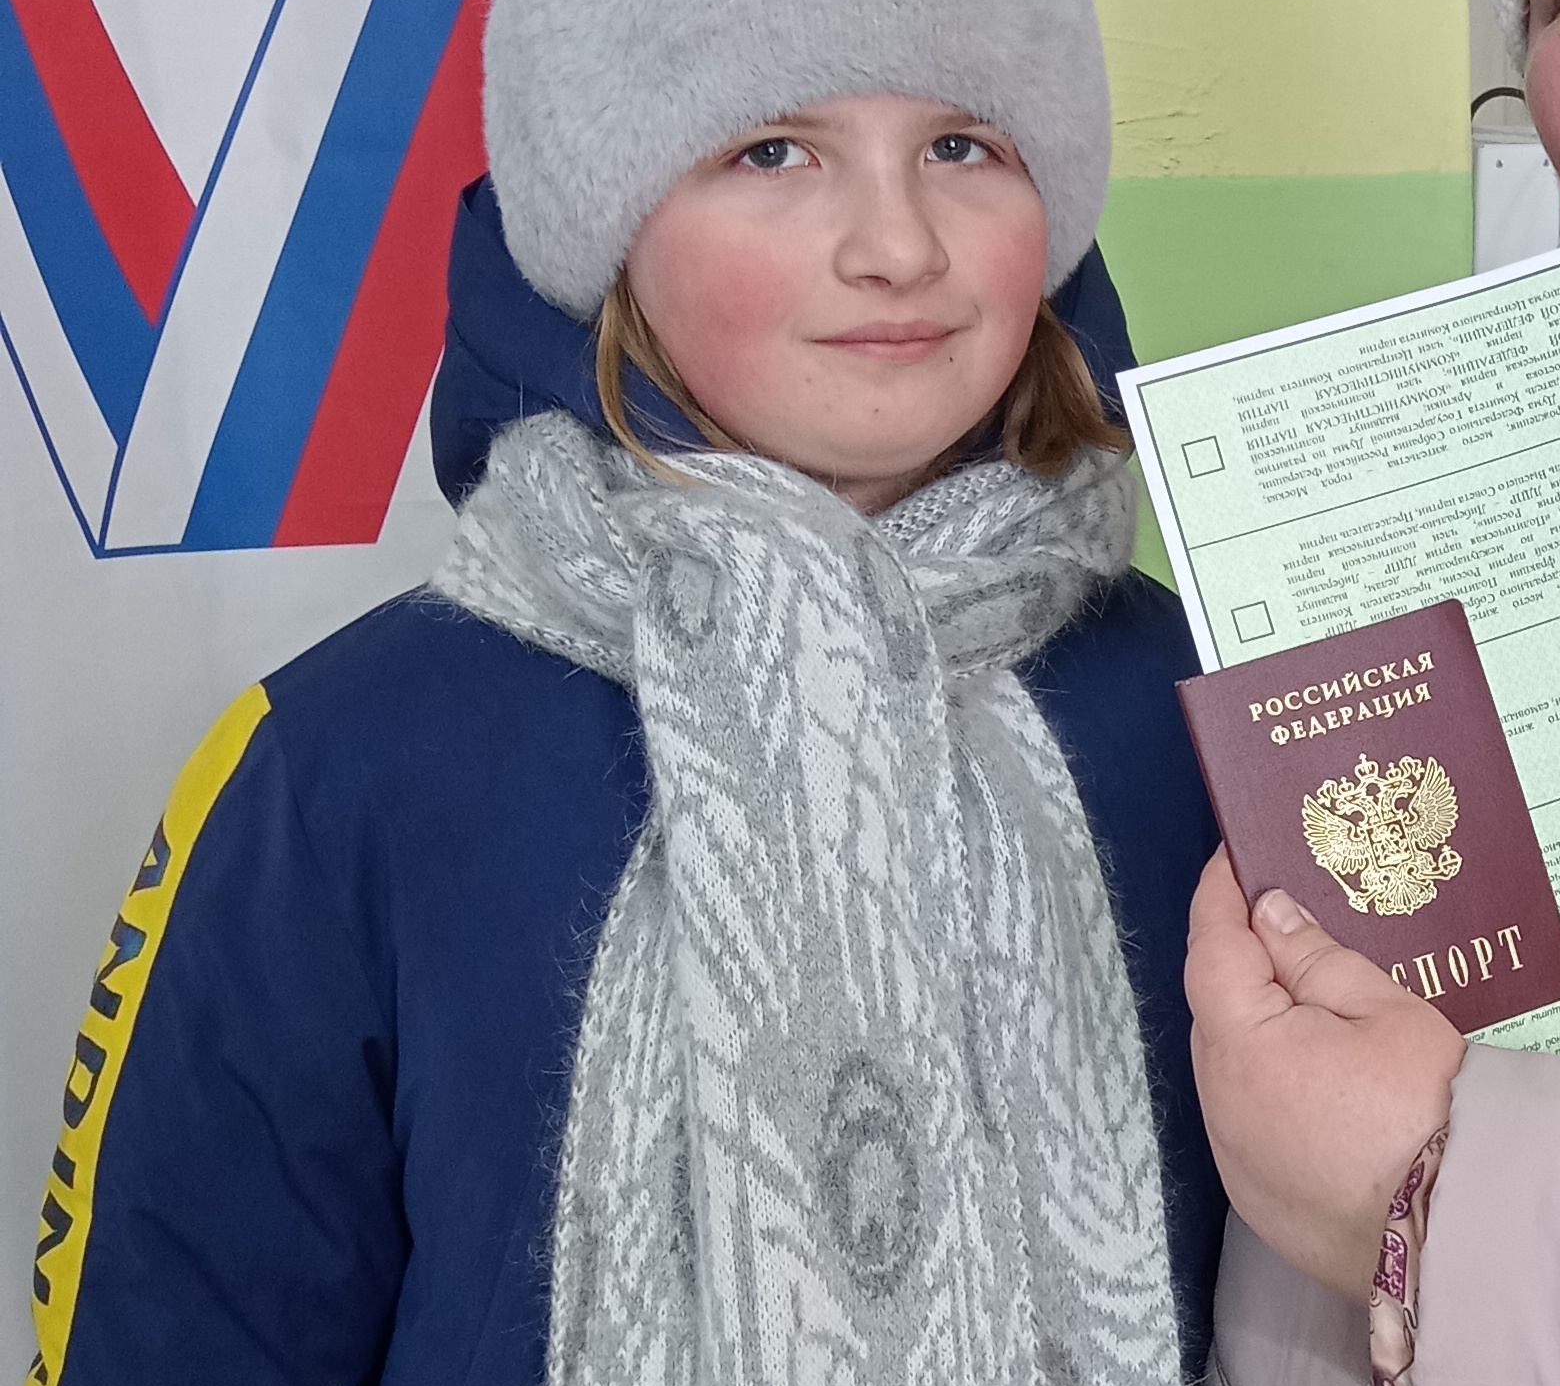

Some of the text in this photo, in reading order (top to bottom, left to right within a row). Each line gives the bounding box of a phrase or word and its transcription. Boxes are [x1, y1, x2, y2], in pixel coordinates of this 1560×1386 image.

[1417, 340, 1445, 355] член
[1337, 348, 1414, 377] Центрального
[1279, 371, 1334, 393] Комитета
[1395, 376, 1423, 391] член
[1459, 368, 1498, 387] партия
[1232, 387, 1275, 405] партии,
[1300, 389, 1376, 420] политической
[1422, 390, 1473, 413] Арктики;
[1467, 390, 1521, 415] Комитета
[1526, 392, 1557, 410] Дума
[1240, 417, 1280, 435] партии
[1348, 412, 1401, 435] выдвинут
[1369, 409, 1463, 446] Государственной
[1448, 401, 1525, 435] Федерального
[1245, 427, 1298, 452] ПАРТИЯ
[1331, 436, 1364, 455] Думы
[1392, 430, 1446, 452] Собрания
[1461, 429, 1494, 446] место
[1249, 434, 1326, 465] политической
[1311, 449, 1327, 460] по
[1325, 446, 1390, 474] Российской
[1386, 444, 1449, 469] жительства
[1254, 452, 1307, 476] развитию
[1258, 466, 1323, 490] Федерации,
[1320, 471, 1353, 488] город
[1497, 468, 1548, 492] Высшего
[1262, 485, 1309, 504] Москва;
[1457, 485, 1497, 504] Совета
[1414, 497, 1457, 517] партии,
[1339, 510, 1414, 539] Председатель
[1298, 533, 1339, 552] партии
[1520, 532, 1535, 545] по
[1415, 543, 1505, 578] международным
[1424, 541, 1463, 560] партия
[1487, 551, 1527, 571] партии
[1384, 554, 1417, 575] ЛДПР
[1438, 566, 1482, 585] России,
[1508, 554, 1556, 579] фракции
[1291, 572, 1360, 598] Либерально-
[1359, 580, 1432, 610] председатель
[1363, 575, 1400, 593] делам;
[1296, 591, 1349, 613] выдвинут
[1511, 589, 1545, 609] место
[1299, 605, 1354, 627] Комитета
[1248, 651, 1436, 722] РОССИЙСКАЯ
[1269, 682, 1433, 747] ФЕДЕРАЦИЯ
[1391, 924, 1524, 1000] СПОРТ
